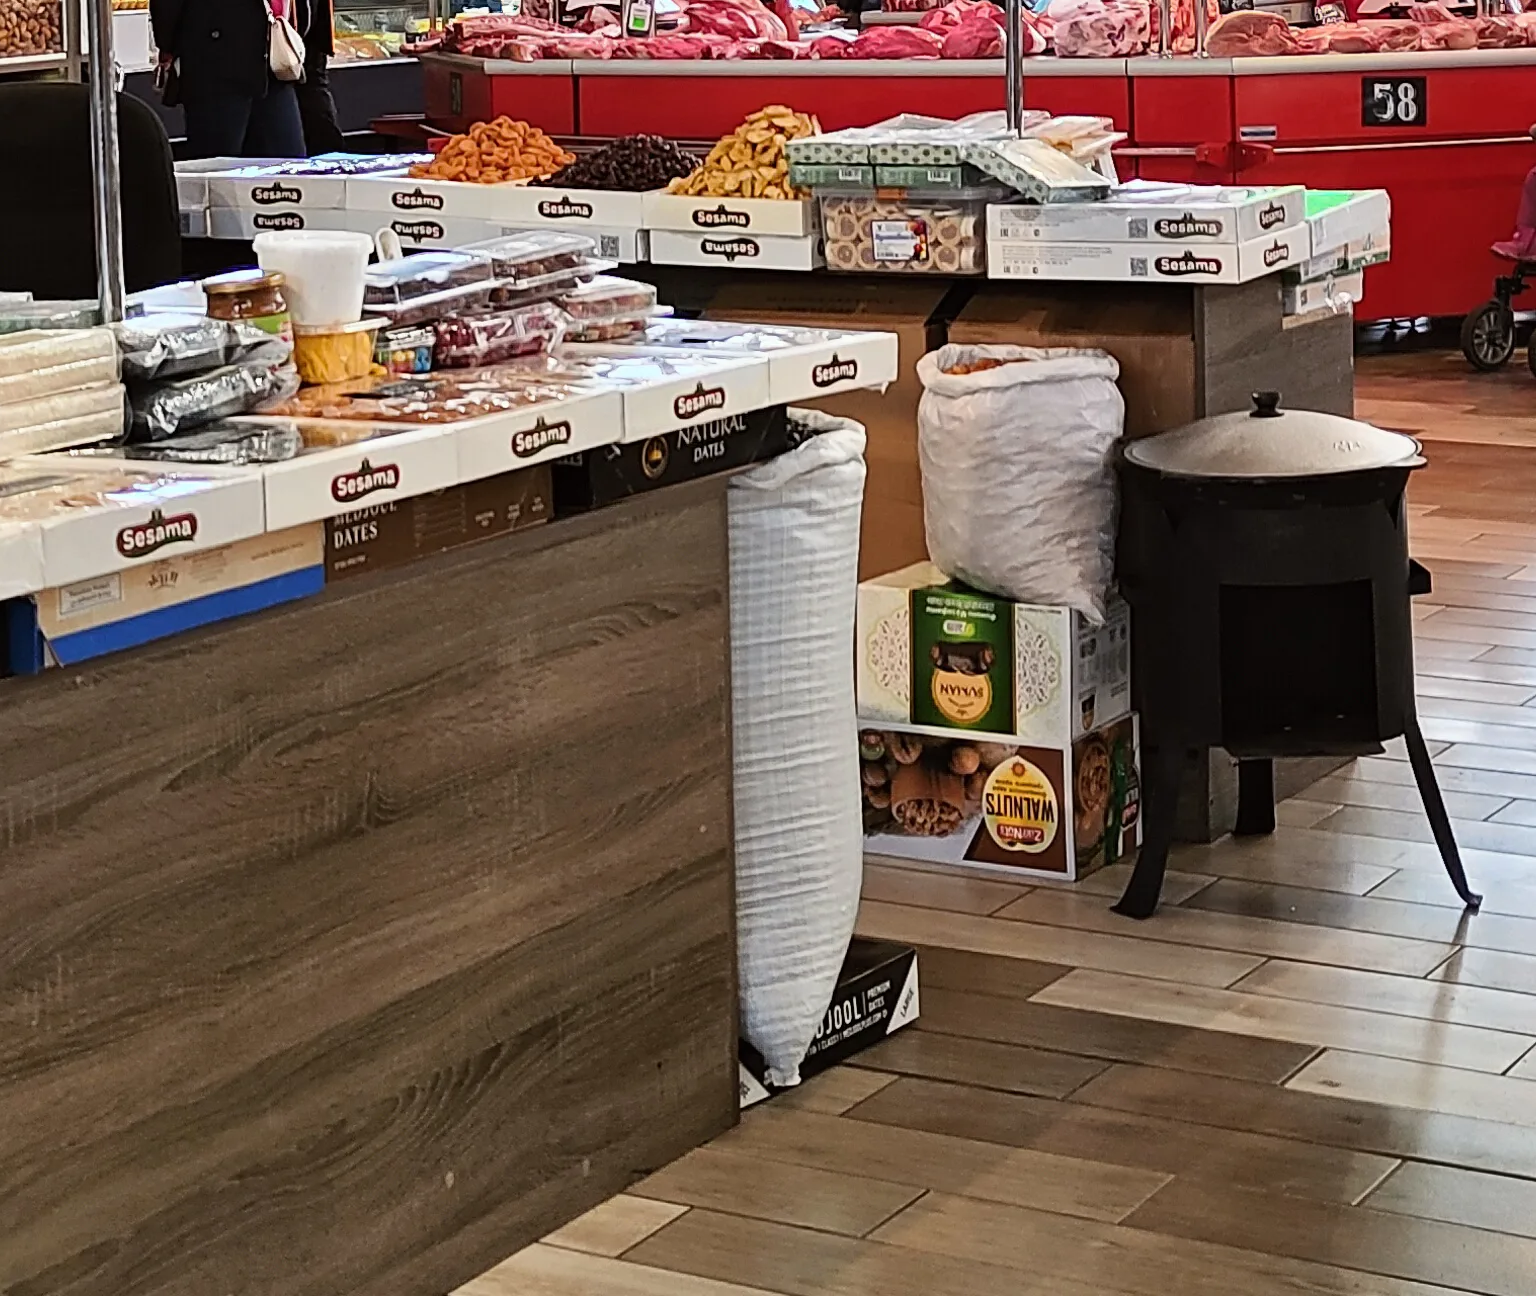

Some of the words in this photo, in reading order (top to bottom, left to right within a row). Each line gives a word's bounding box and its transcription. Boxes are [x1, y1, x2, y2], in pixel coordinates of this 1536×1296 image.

[1372, 81, 1418, 124] 58
[255, 188, 299, 202] Sesama
[395, 193, 442, 209] Sesama
[542, 202, 590, 217] Sesama
[696, 211, 747, 226] Sesama
[256, 216, 301, 229] Sesama
[394, 224, 441, 238] Sesama
[1159, 220, 1219, 236] Sesama
[704, 241, 756, 255] Sesama
[1159, 257, 1219, 274] Sesama
[815, 362, 855, 384] Sesama
[676, 390, 723, 416] Sesama
[514, 424, 568, 454] Sesama
[676, 414, 749, 450] NATURAL
[693, 439, 726, 464] DATES
[336, 468, 397, 498] Sesama
[121, 516, 195, 553] Sesama
[334, 520, 379, 550] DATES
[939, 682, 985, 699] SUMAN
[985, 792, 1055, 824] WALNUTS
